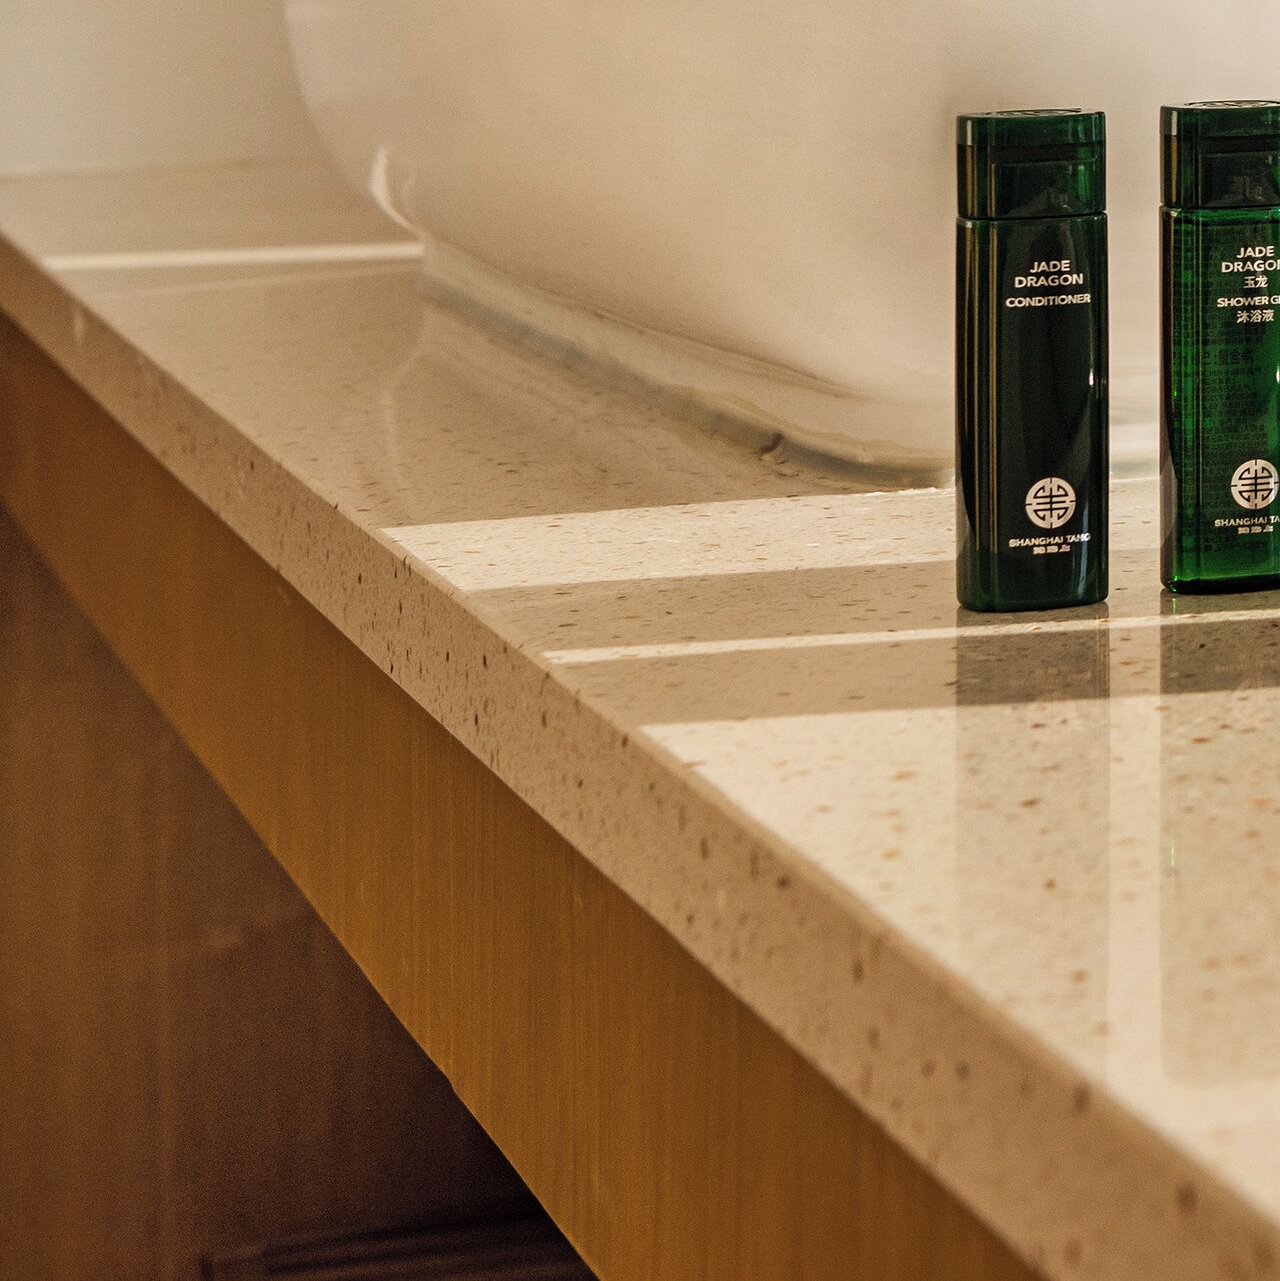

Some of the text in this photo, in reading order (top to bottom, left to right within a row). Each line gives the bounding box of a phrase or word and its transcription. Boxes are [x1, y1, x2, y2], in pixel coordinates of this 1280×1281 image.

[1236, 246, 1275, 258] JADE
[1030, 260, 1070, 273] JADE
[1014, 273, 1083, 288] DRAGON
[1006, 293, 1091, 307] CONDITIONER
[1217, 296, 1268, 307] SHOWER
[1215, 517, 1267, 527] SHANGHAI
[1009, 537, 1063, 547] SHANGHAI
